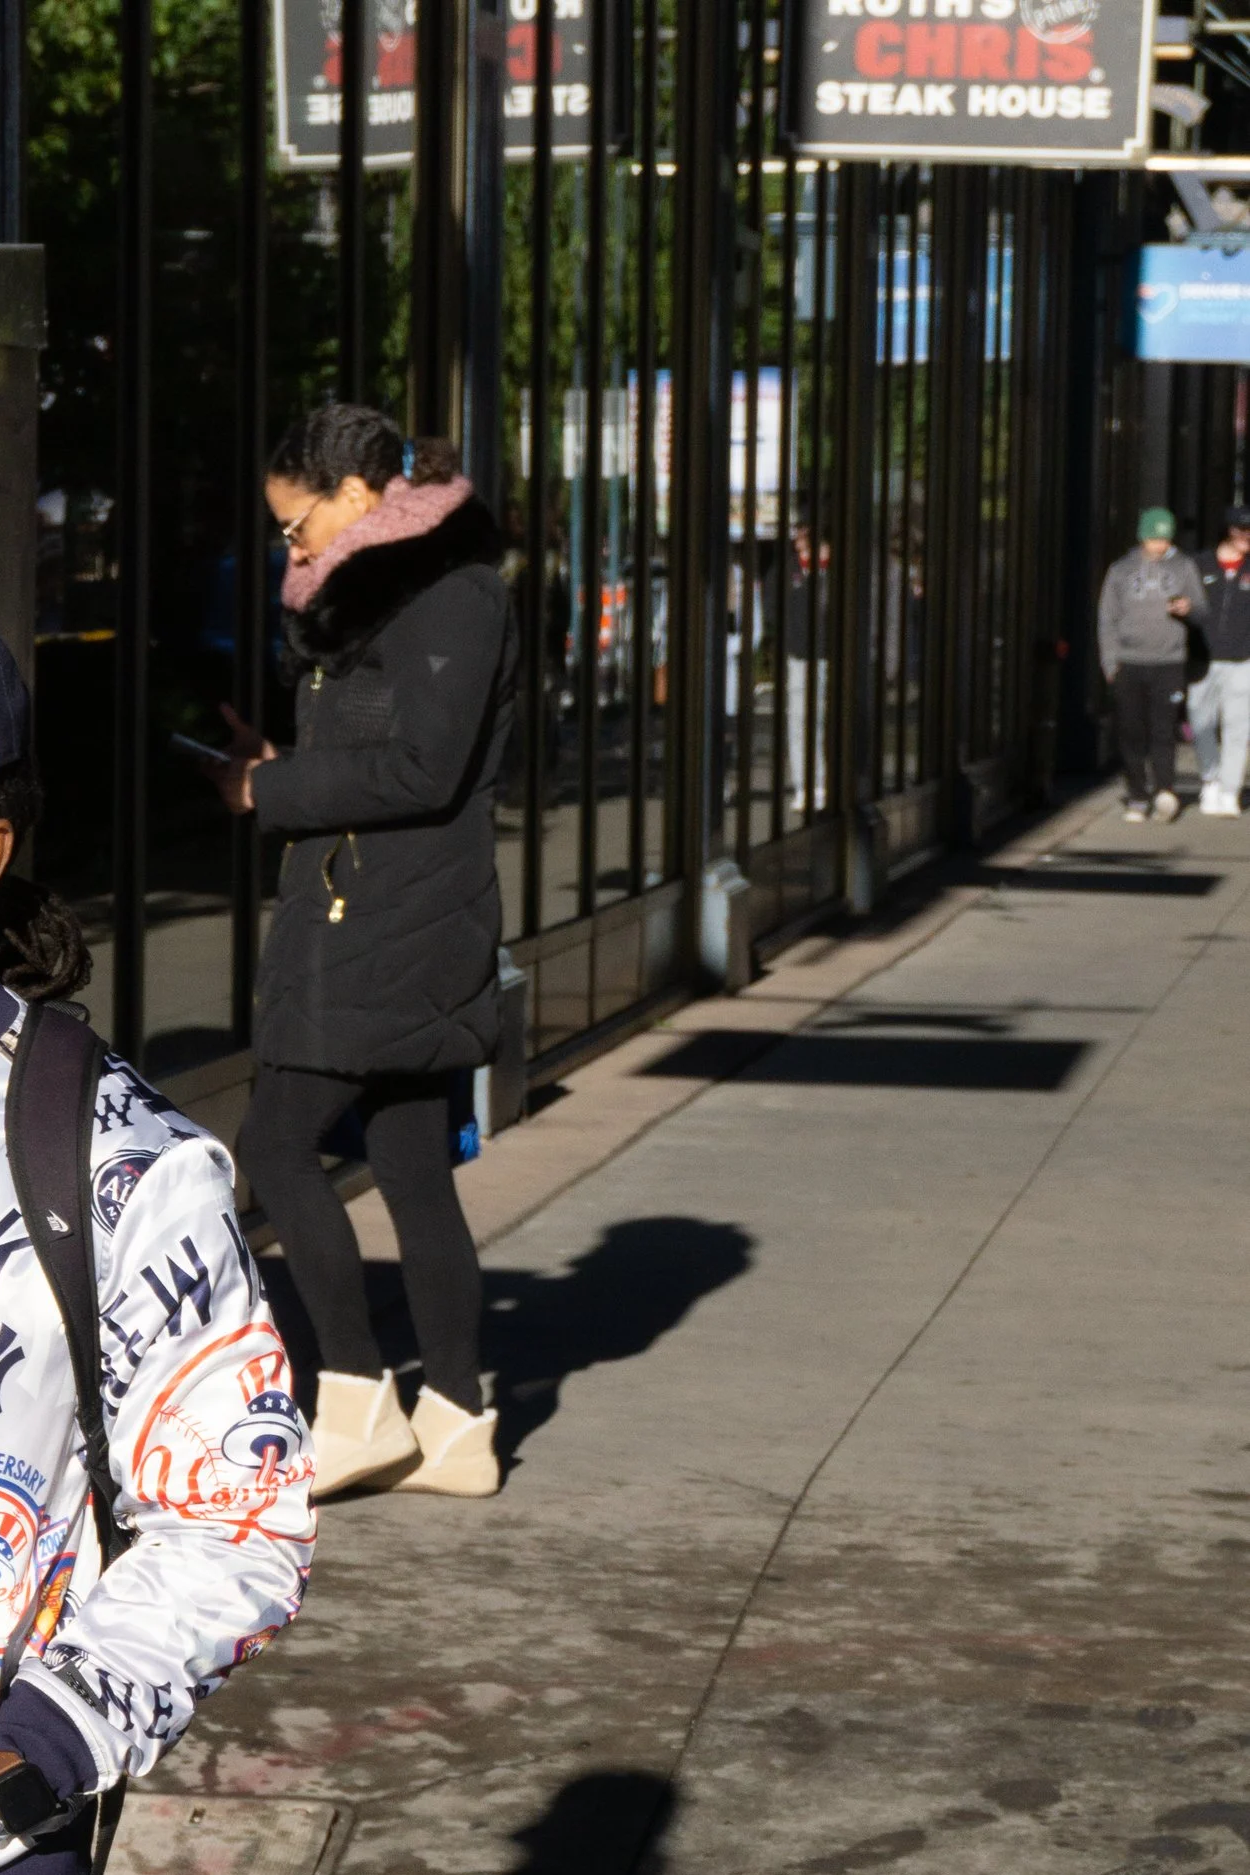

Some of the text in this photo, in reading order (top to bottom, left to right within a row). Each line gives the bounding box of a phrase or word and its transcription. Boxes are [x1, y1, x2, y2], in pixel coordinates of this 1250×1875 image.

[854, 19, 1095, 82] CHRIS
[816, 82, 1112, 119] STEAK HOUSE
